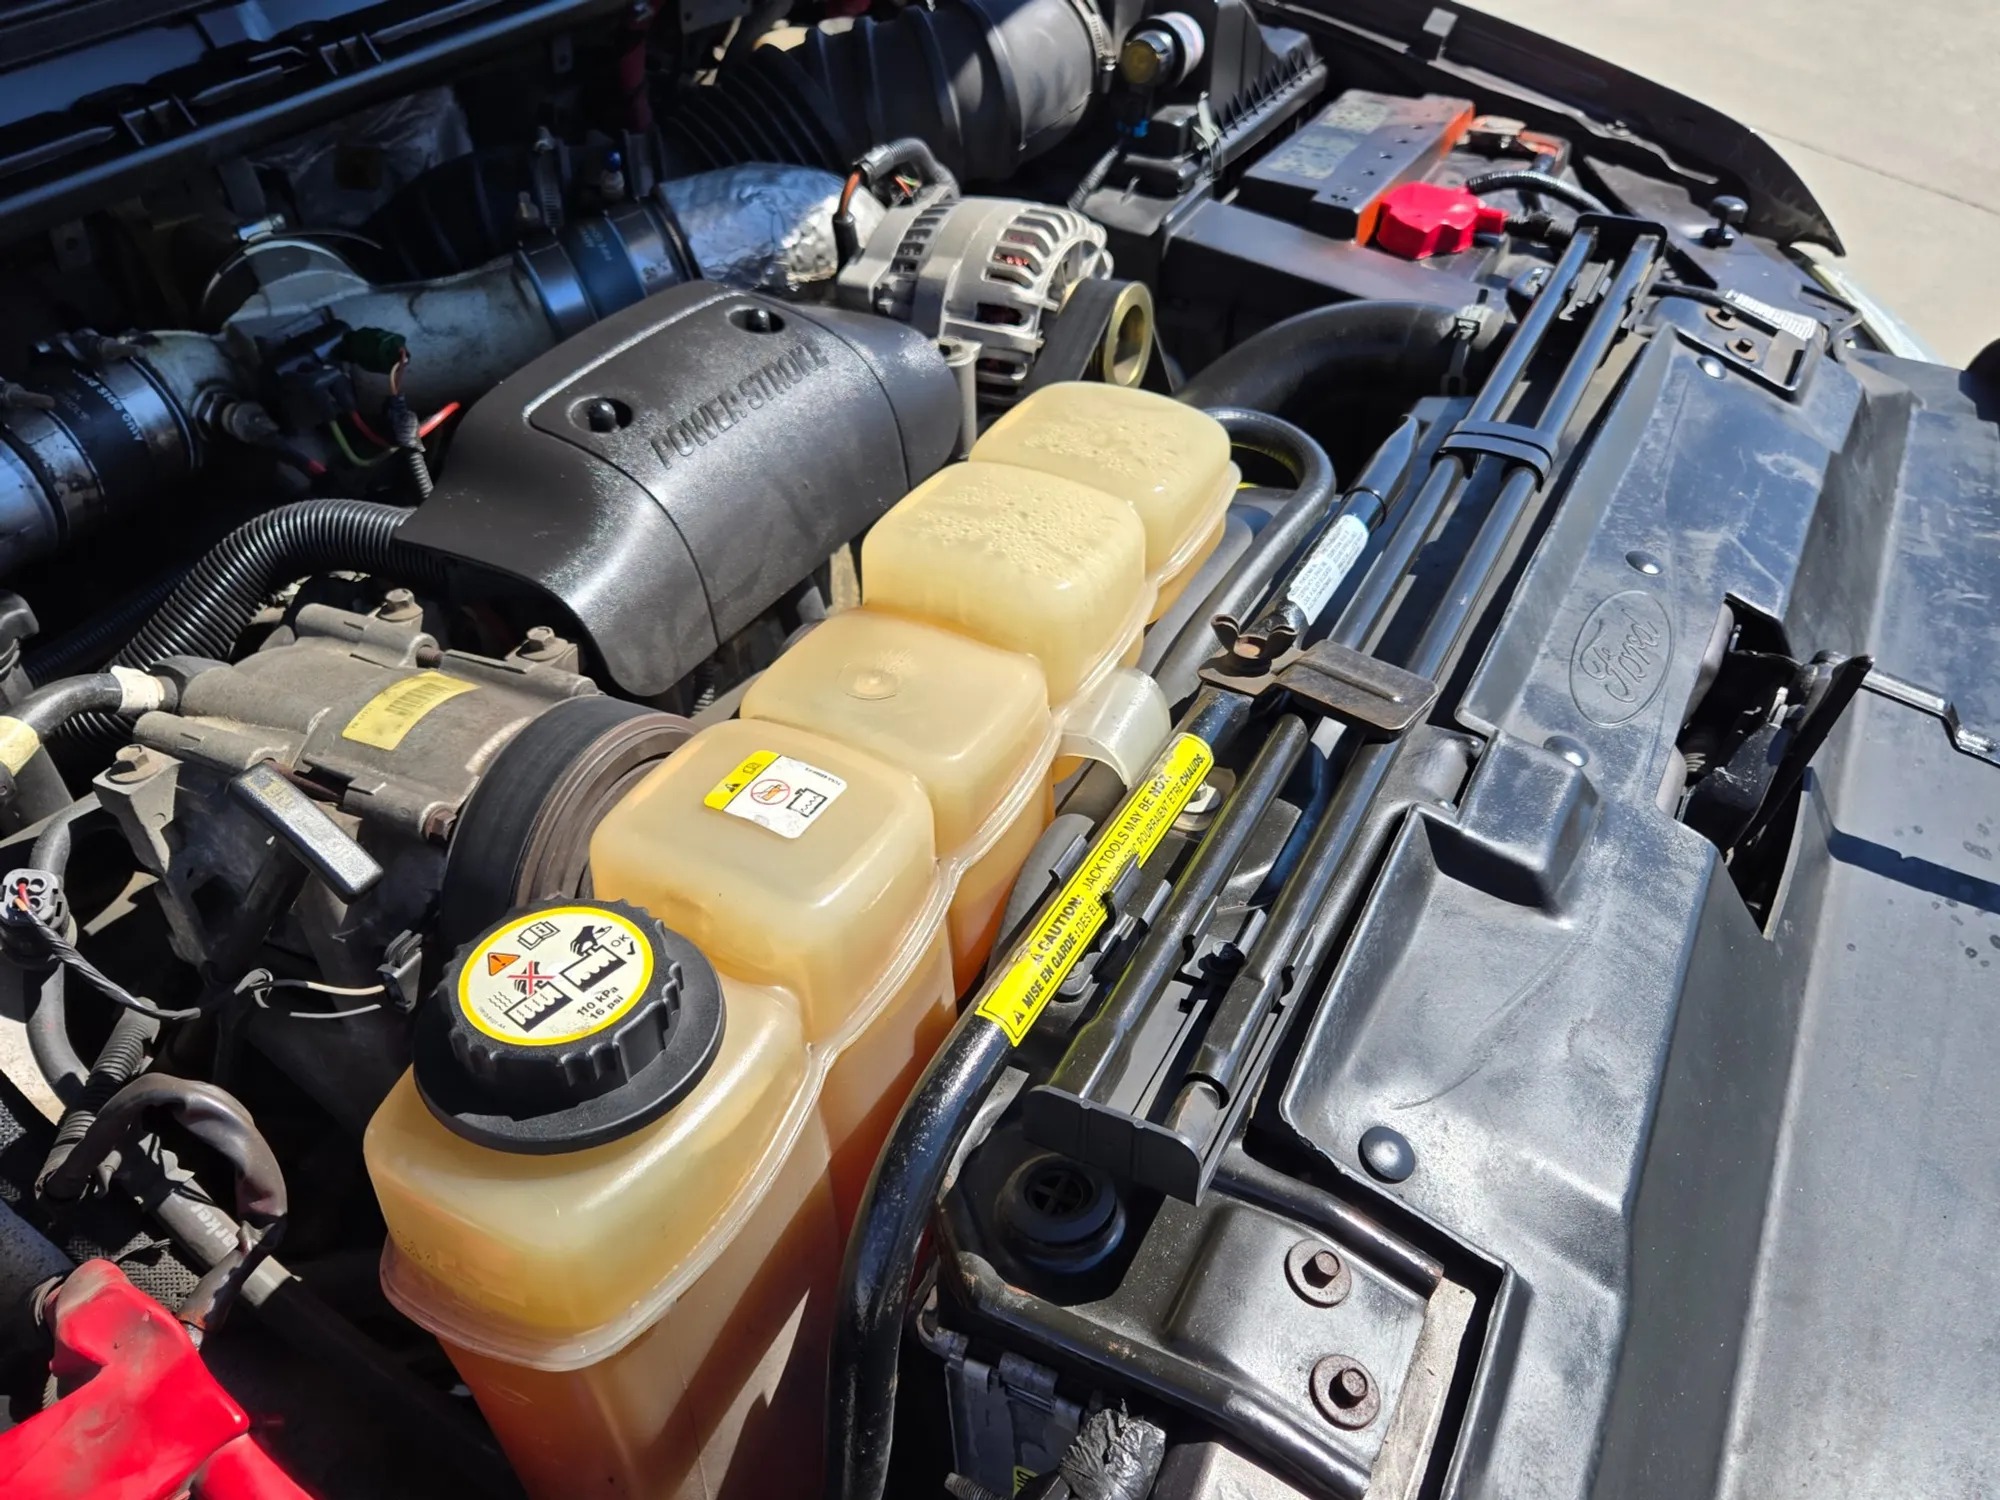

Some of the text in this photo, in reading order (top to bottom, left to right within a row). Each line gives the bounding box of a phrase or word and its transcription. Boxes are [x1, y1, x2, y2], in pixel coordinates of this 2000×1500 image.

[651, 336, 830, 470] POWER STROKE
[1579, 608, 1661, 704] Ford
[1021, 980, 1044, 1010] MISE
[1039, 963, 1056, 985] EN
[1076, 913, 1093, 934] DES
[1136, 801, 1170, 847] POURRAIENT
[1179, 753, 1206, 786] CHAUDS.
[1037, 894, 1085, 951] CAUTION:
[1082, 863, 1105, 891] JACK
[1100, 831, 1129, 861] TOOLS
[1124, 811, 1144, 833] MAY
[1138, 796, 1154, 812] BE
[610, 933, 631, 948] OK
[576, 985, 620, 1017] 110 kPa
[589, 995, 625, 1021] 16 psi
[190, 1203, 238, 1248] arker
